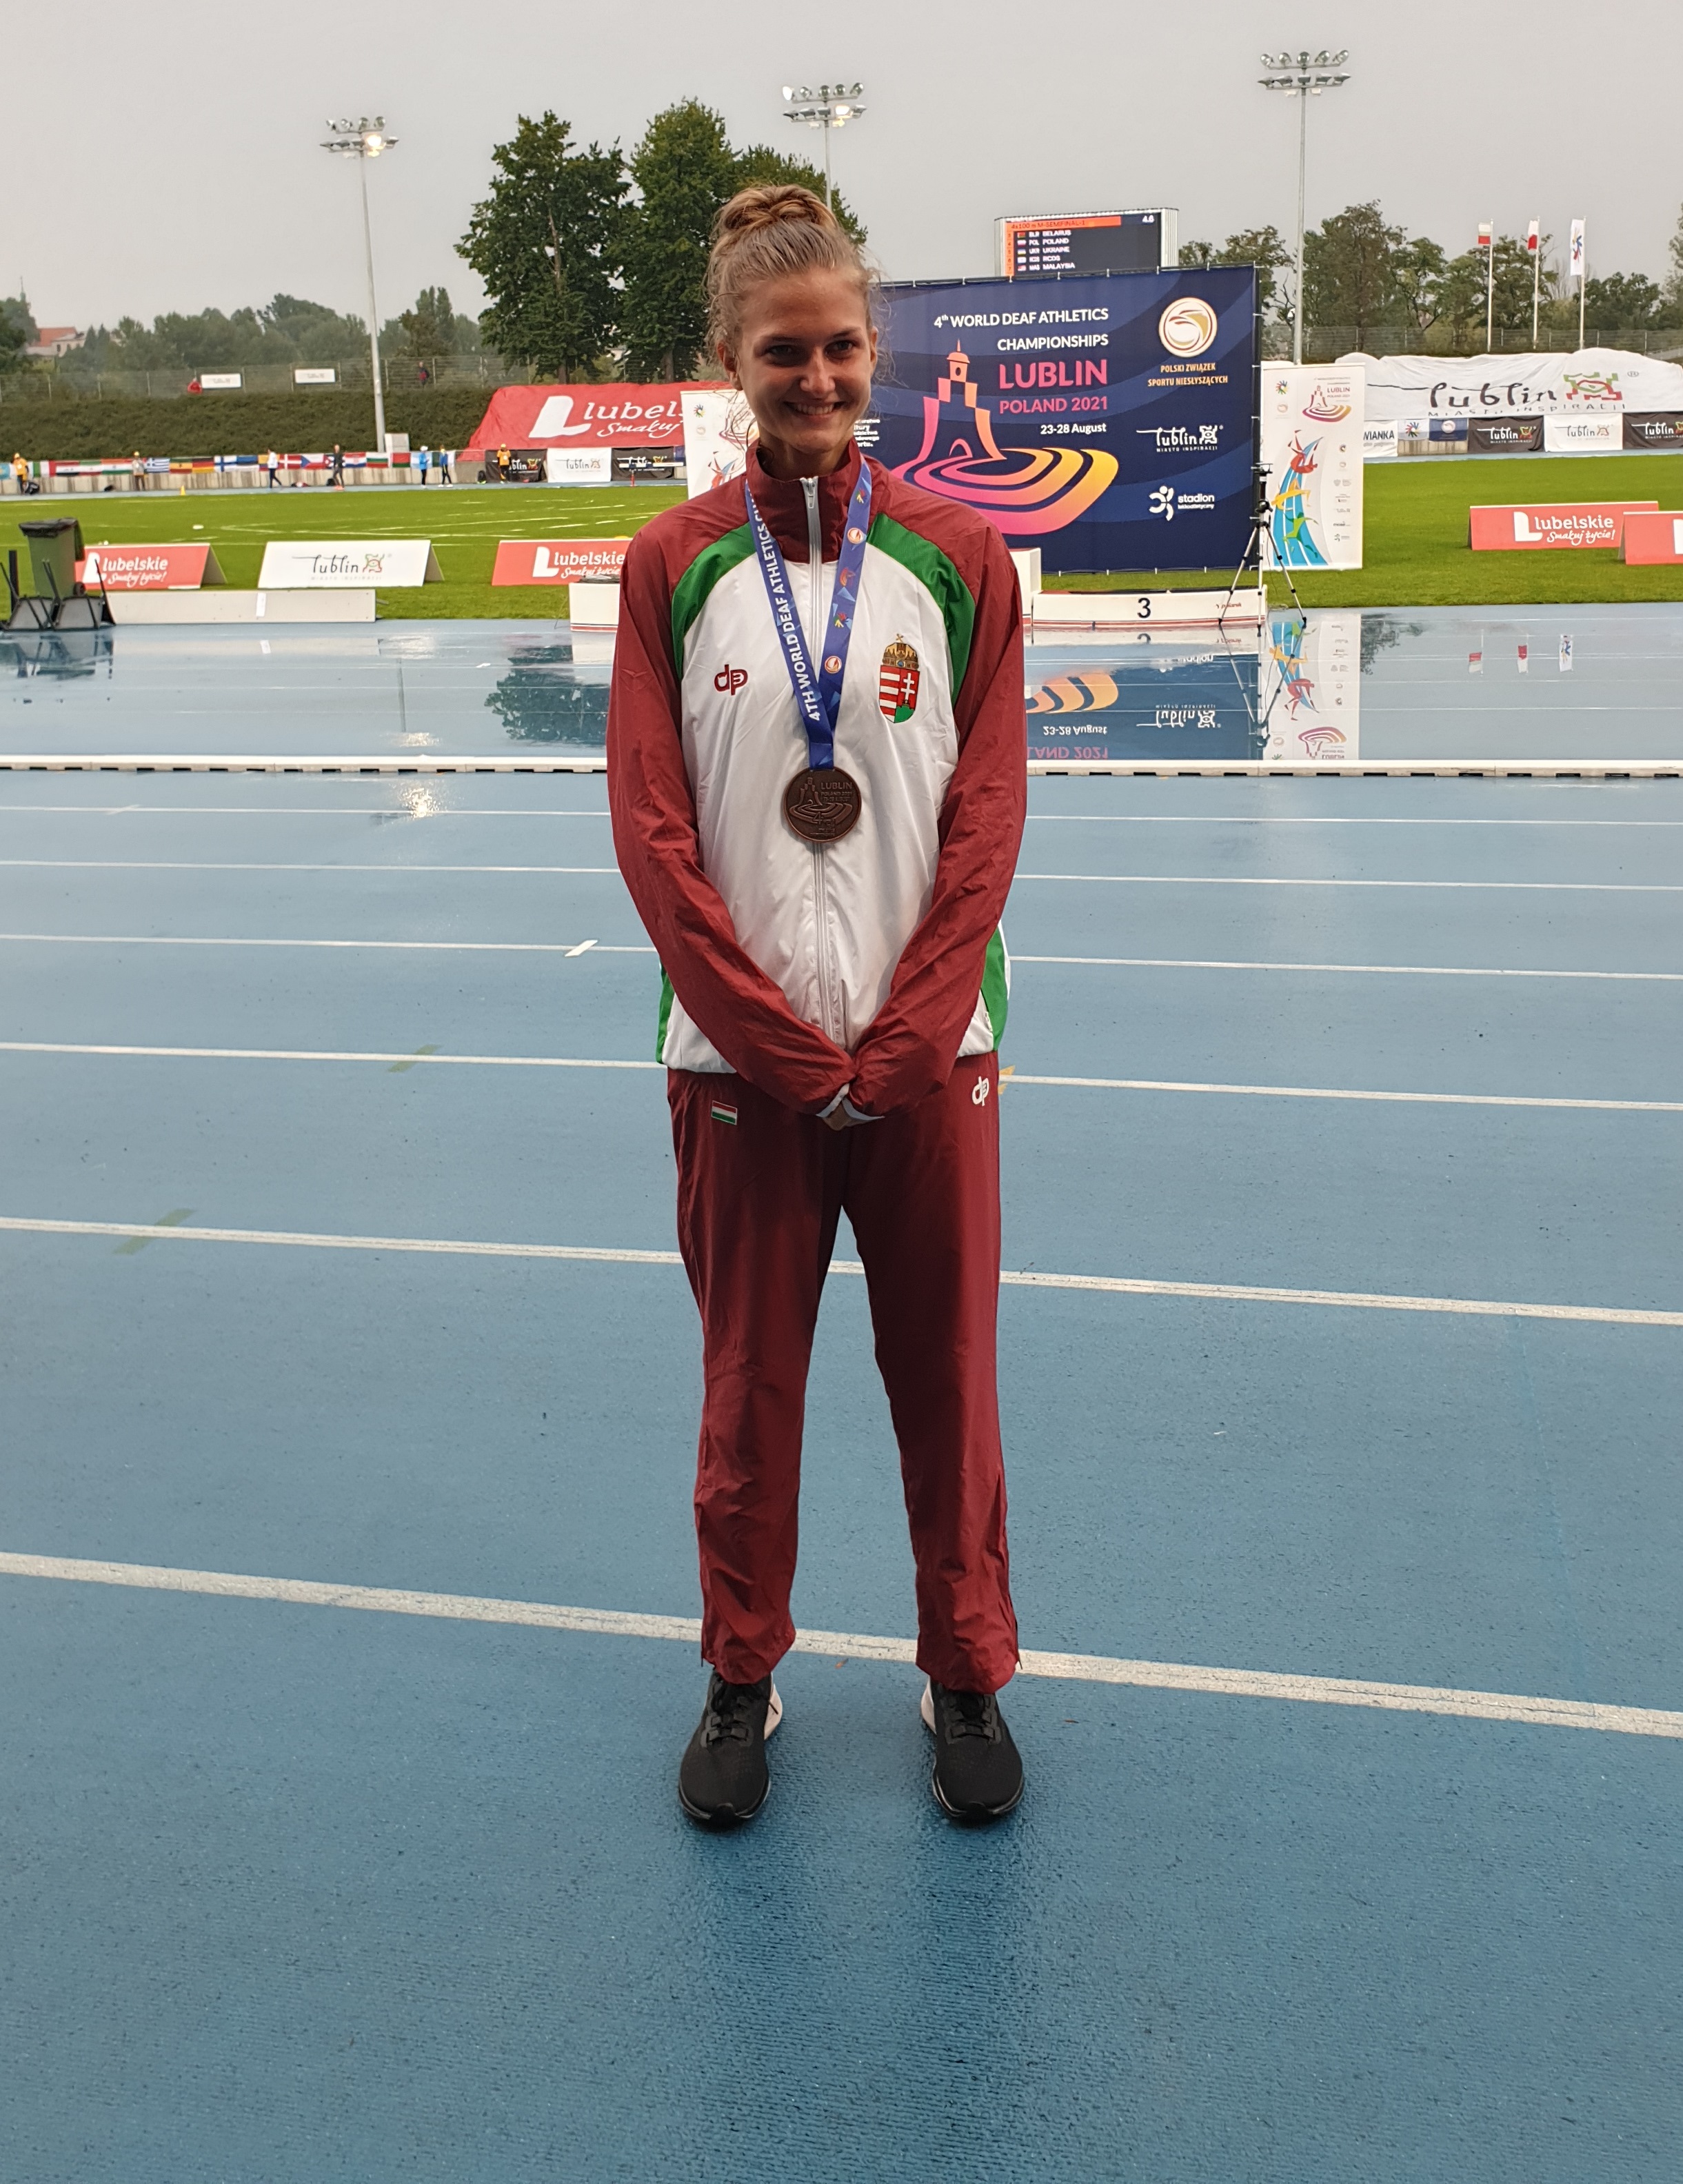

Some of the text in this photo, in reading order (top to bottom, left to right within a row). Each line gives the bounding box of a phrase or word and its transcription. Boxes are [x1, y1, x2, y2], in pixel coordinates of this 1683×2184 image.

[934, 308, 1109, 329] 4th WORLD DEAF ATHLETICS
[997, 334, 1109, 351] CHAMPIONSHIPS
[999, 359, 1107, 390] LUBLIN
[1160, 363, 1216, 373] POLSKI ZWIĄZEK
[1147, 375, 1229, 387] SPORTU NIESŁYSZĄCYCH
[584, 401, 683, 420] lubel
[1000, 396, 1108, 414] POLAND 2021
[597, 420, 683, 439] Smakuj
[1040, 423, 1107, 435] 23-28 August
[1178, 493, 1215, 503] stadion
[1534, 515, 1614, 530] lubelskie
[1546, 530, 1584, 546] Smakuj
[103, 556, 168, 572] lubelskie
[554, 551, 625, 565] lubelskie
[108, 572, 141, 588] Smakuj
[1137, 597, 1151, 619] 3
[758, 522, 820, 721] 4TH WORLD DEAF ATHLETICS
